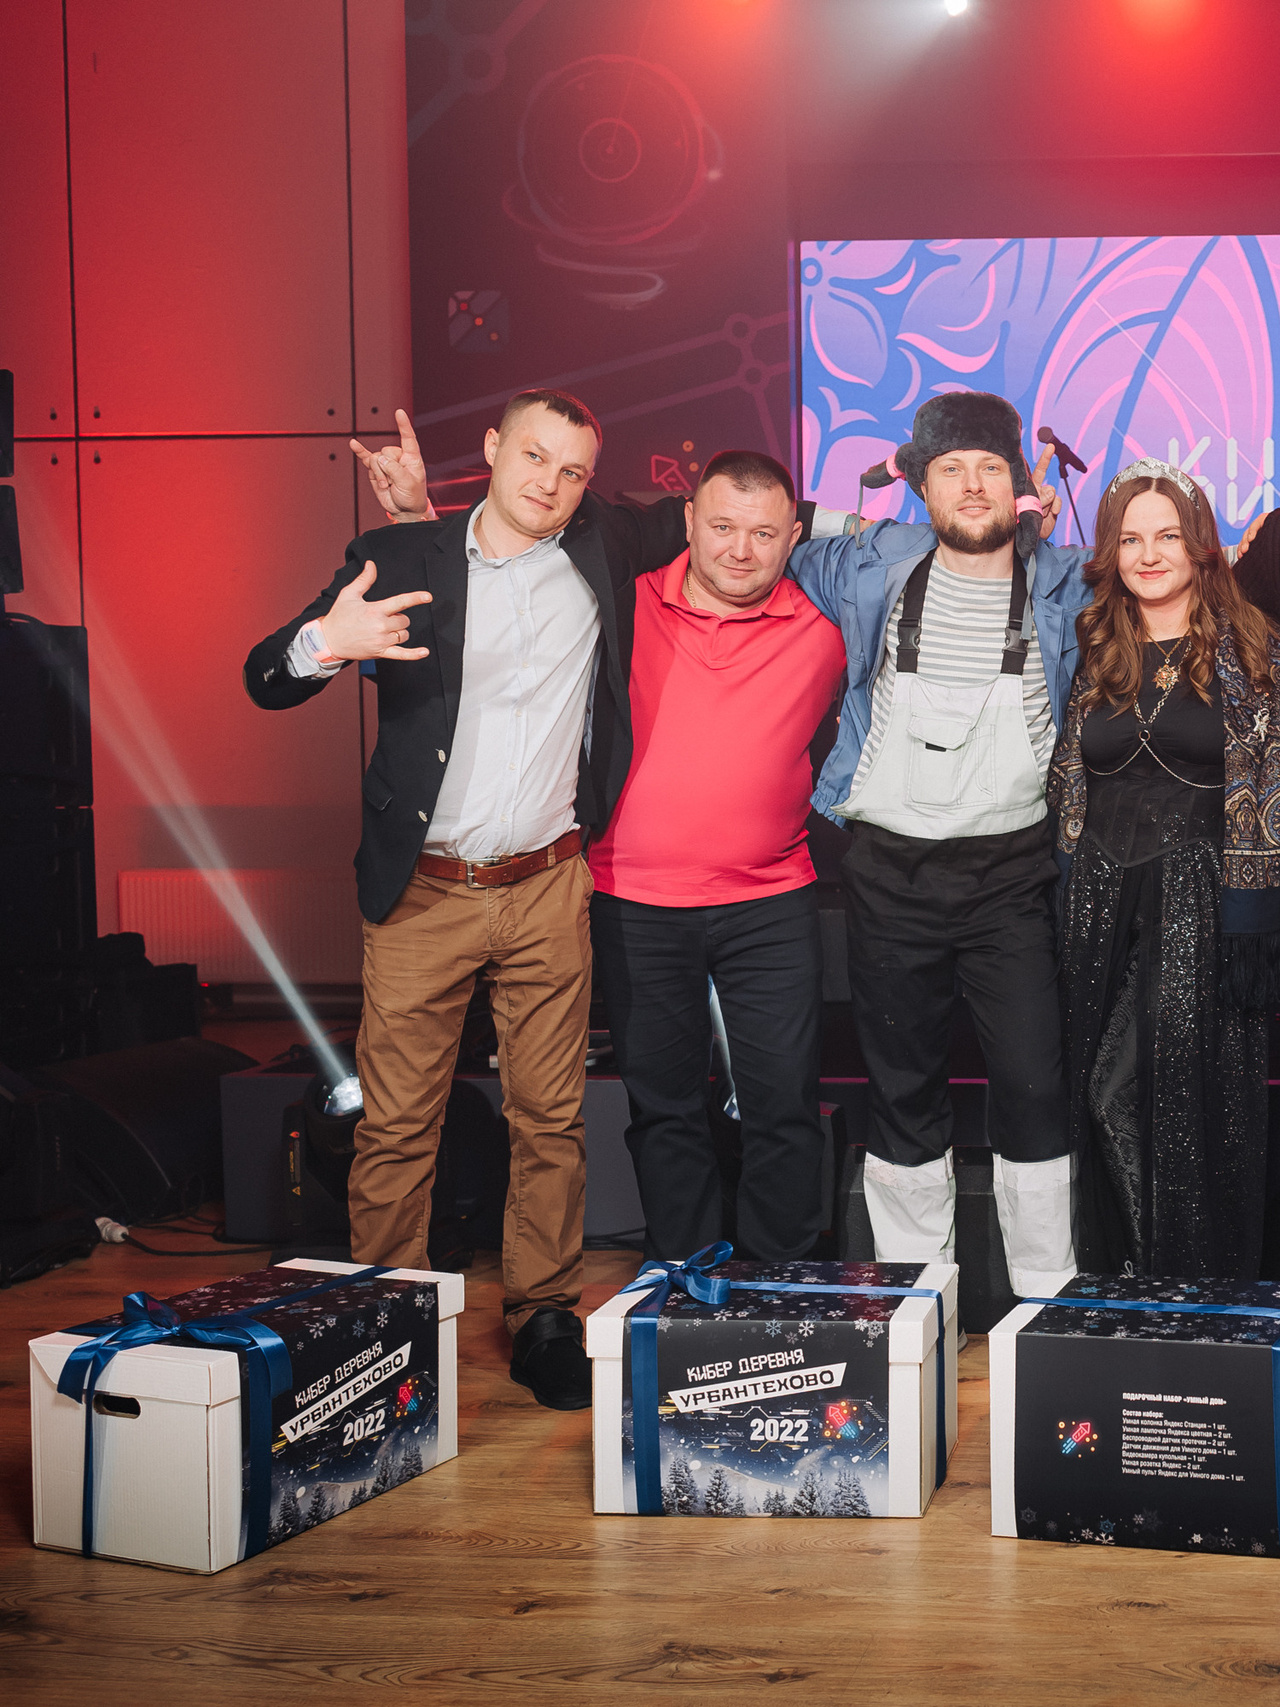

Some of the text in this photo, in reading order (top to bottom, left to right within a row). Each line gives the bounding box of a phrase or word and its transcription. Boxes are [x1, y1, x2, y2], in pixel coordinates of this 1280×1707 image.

[687, 1349, 805, 1383] КИБЕР ДЕРЕВНЯ
[294, 1341, 383, 1408] КИБЕР ДЕРЕВНЯ
[289, 1353, 403, 1436] УРБАНТЕХОВО
[679, 1370, 834, 1408] УРБАНТЕХОВО
[1163, 1394, 1182, 1402] НАБОР
[1122, 1409, 1164, 1419] Состав набора:
[342, 1408, 386, 1447] 2022
[750, 1418, 809, 1441] 2022
[1122, 1417, 1139, 1425] Умная
[1140, 1419, 1163, 1427] колонка
[1163, 1419, 1183, 1428] Яндекс
[1183, 1421, 1207, 1430] Станция
[1122, 1425, 1139, 1433] Умная
[1167, 1428, 1190, 1436] Яндекса
[1122, 1434, 1161, 1443] Беспроводной
[1122, 1442, 1141, 1450] Датчик
[1142, 1444, 1169, 1452] движения
[1181, 1446, 1202, 1454] Умного
[1122, 1450, 1158, 1460] Видеокамера
[1158, 1453, 1187, 1461] купольная
[1140, 1460, 1161, 1468] розетка
[1162, 1461, 1182, 1469] Яндекс
[1122, 1467, 1140, 1475] Умный
[1157, 1469, 1178, 1477] Яндекс
[1189, 1471, 1210, 1479] Умного
